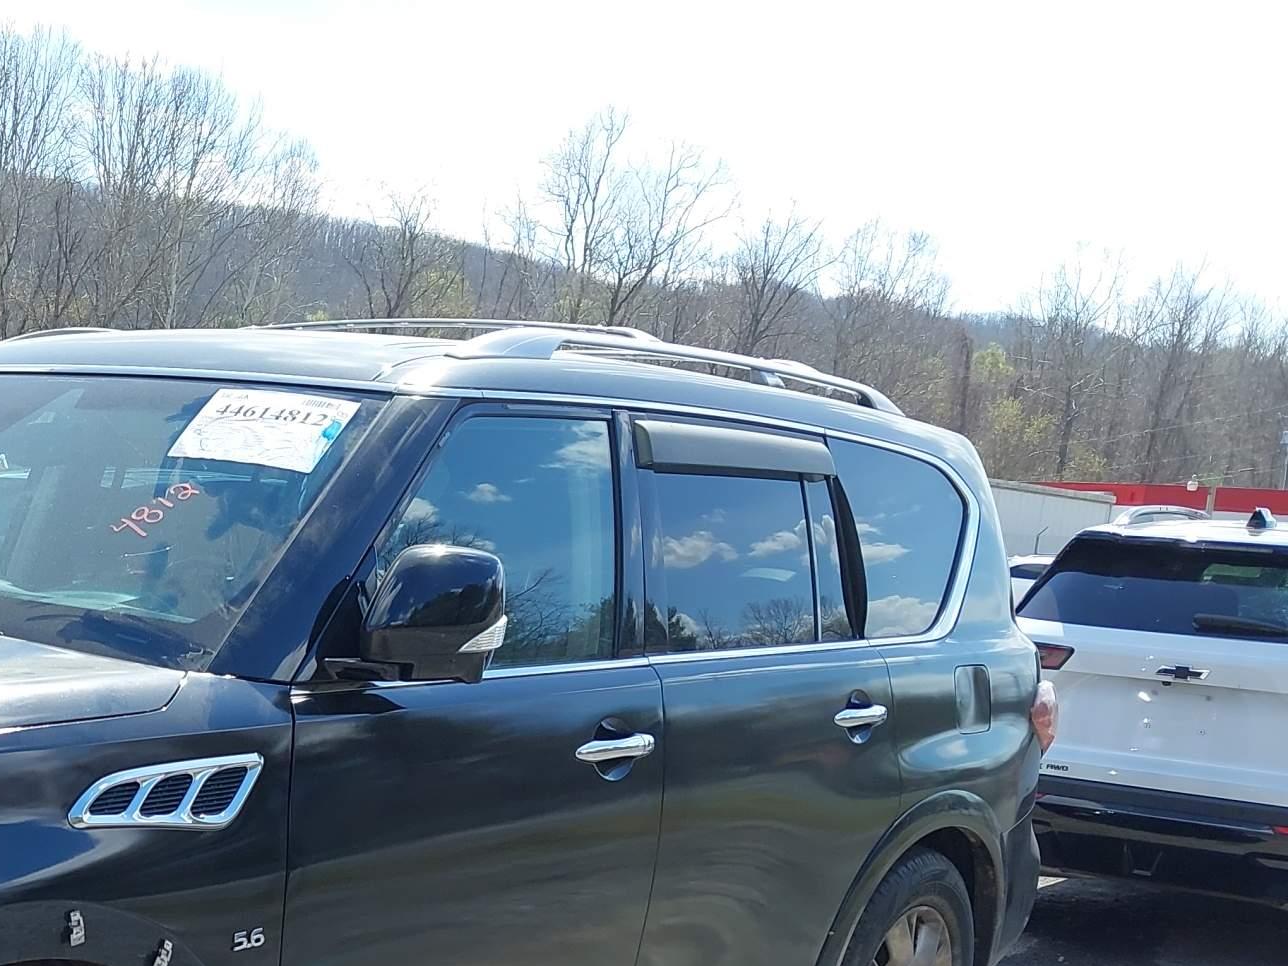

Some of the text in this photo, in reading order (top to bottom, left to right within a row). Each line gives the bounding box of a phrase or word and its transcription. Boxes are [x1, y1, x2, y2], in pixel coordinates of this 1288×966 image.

[216, 403, 329, 426] 44614812
[109, 483, 200, 537] 4812
[1046, 763, 1069, 771] AWD
[233, 927, 264, 951] 5.6
